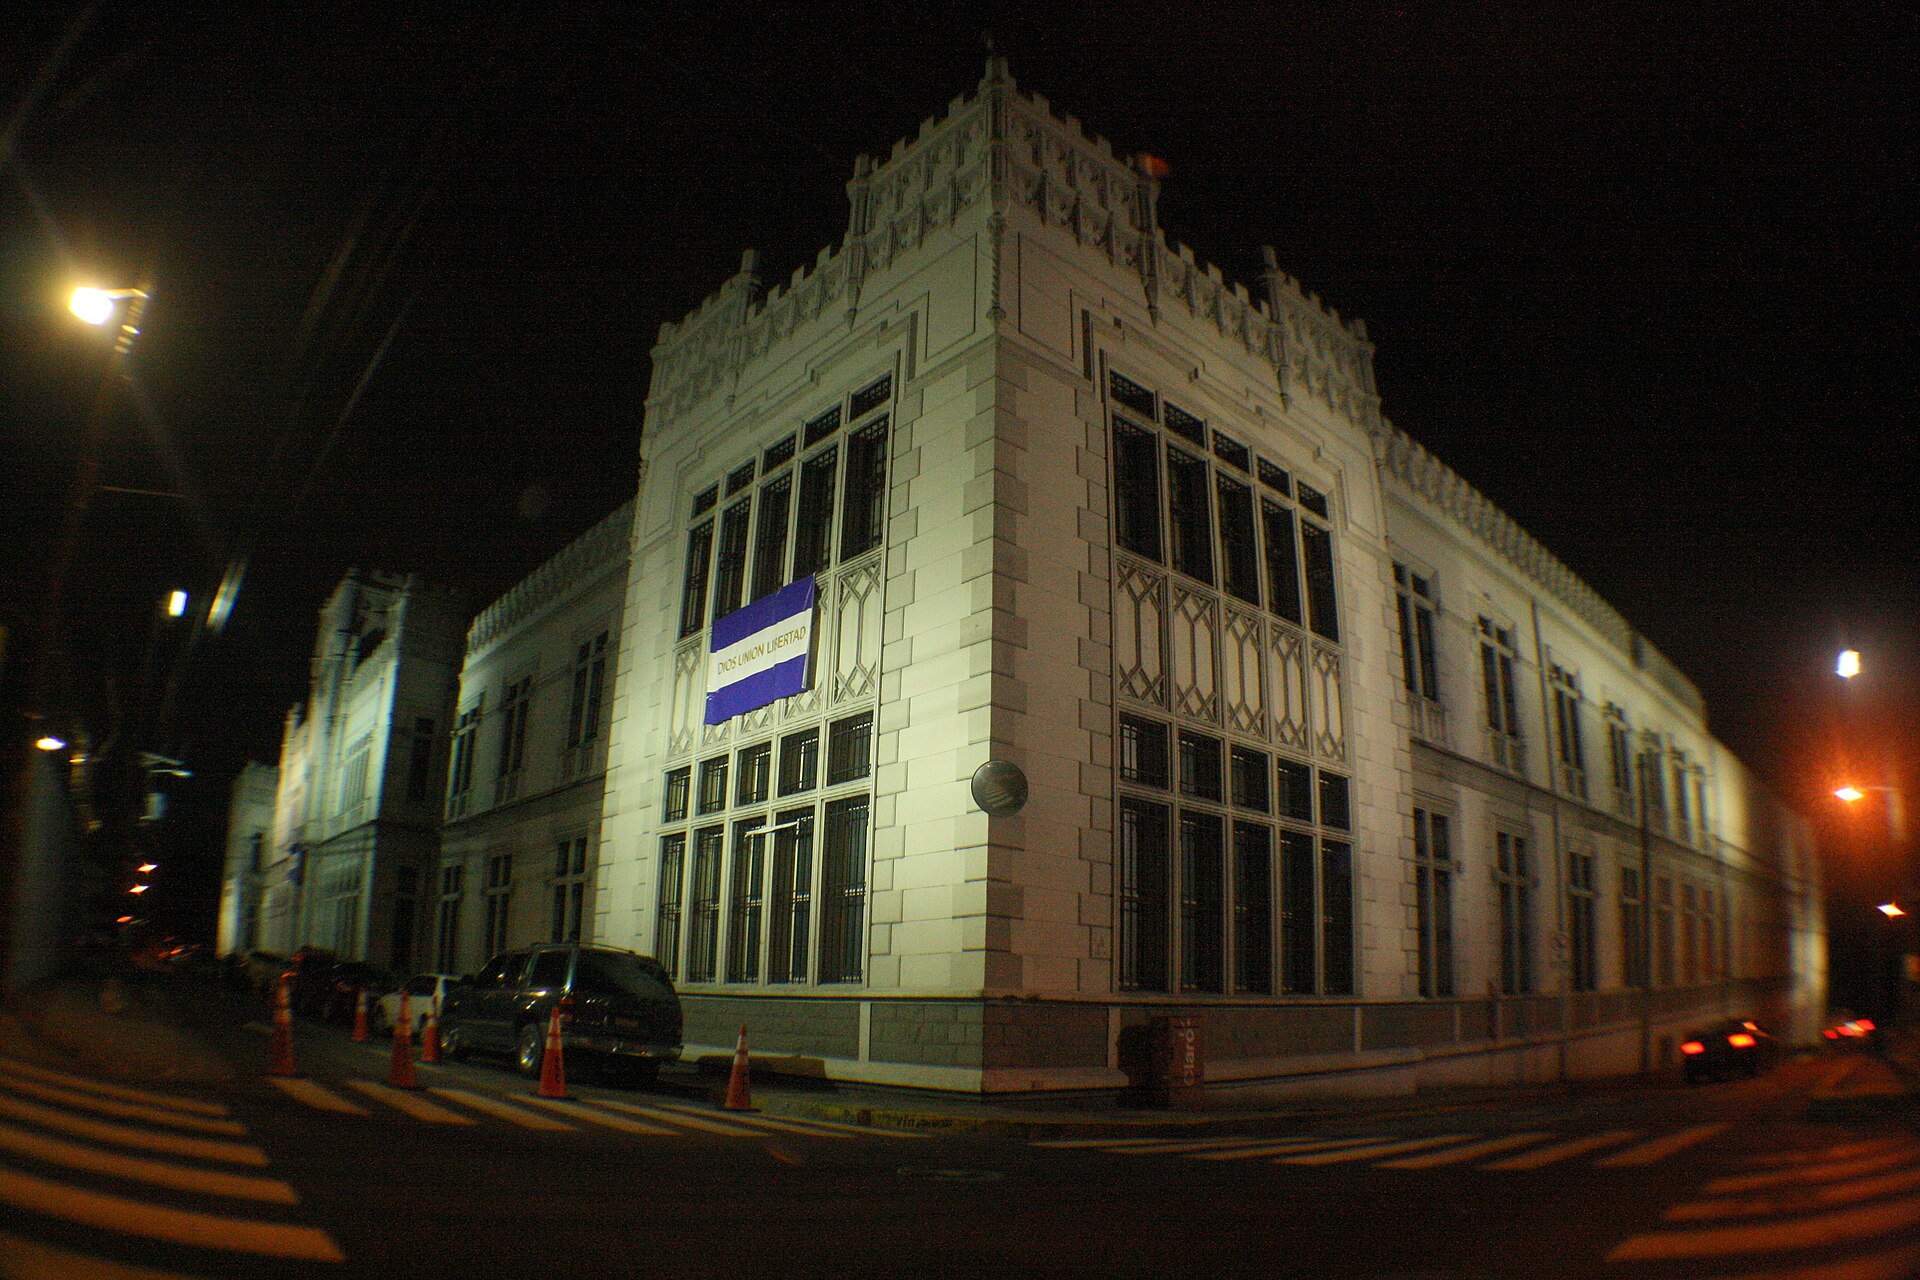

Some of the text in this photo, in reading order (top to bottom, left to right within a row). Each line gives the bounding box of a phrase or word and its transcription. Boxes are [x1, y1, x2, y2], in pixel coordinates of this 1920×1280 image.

[718, 626, 806, 674] DIOS UNION LIBERTAD
[1184, 1027, 1196, 1086] Claro
